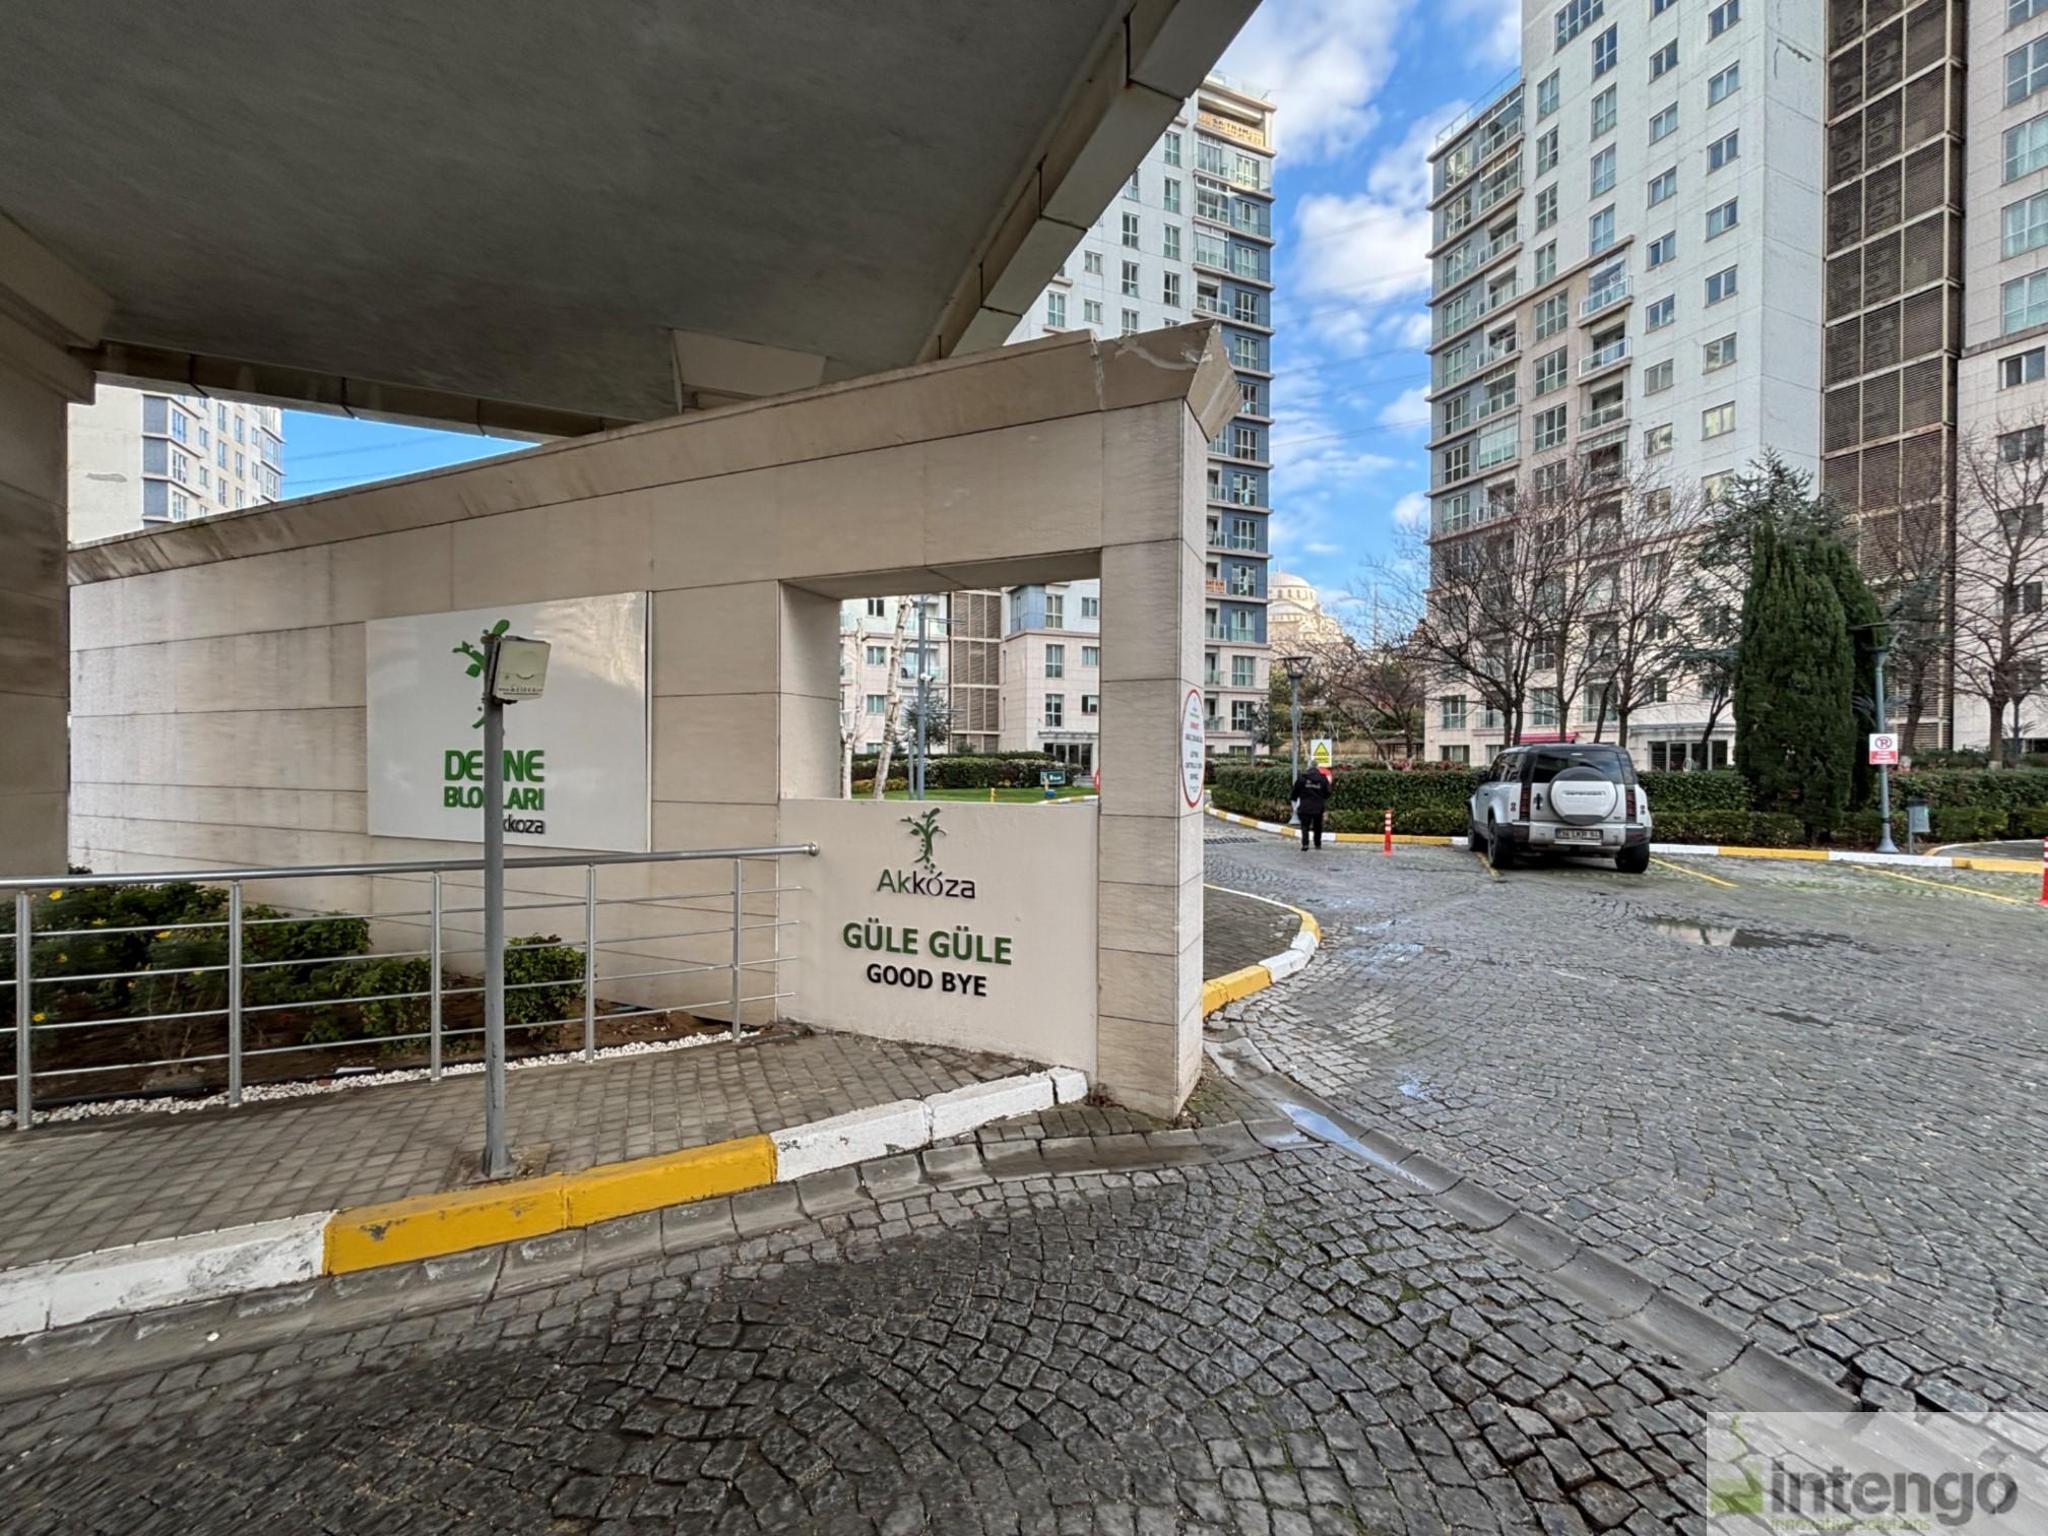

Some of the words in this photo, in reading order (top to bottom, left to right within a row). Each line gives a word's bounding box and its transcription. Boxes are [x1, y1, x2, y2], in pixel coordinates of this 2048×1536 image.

[444, 750, 545, 782] DENE
[843, 916, 918, 955] GÜLE
[928, 925, 1012, 966] GÜLE
[866, 963, 933, 989] GOOD
[941, 971, 987, 997] BYE
